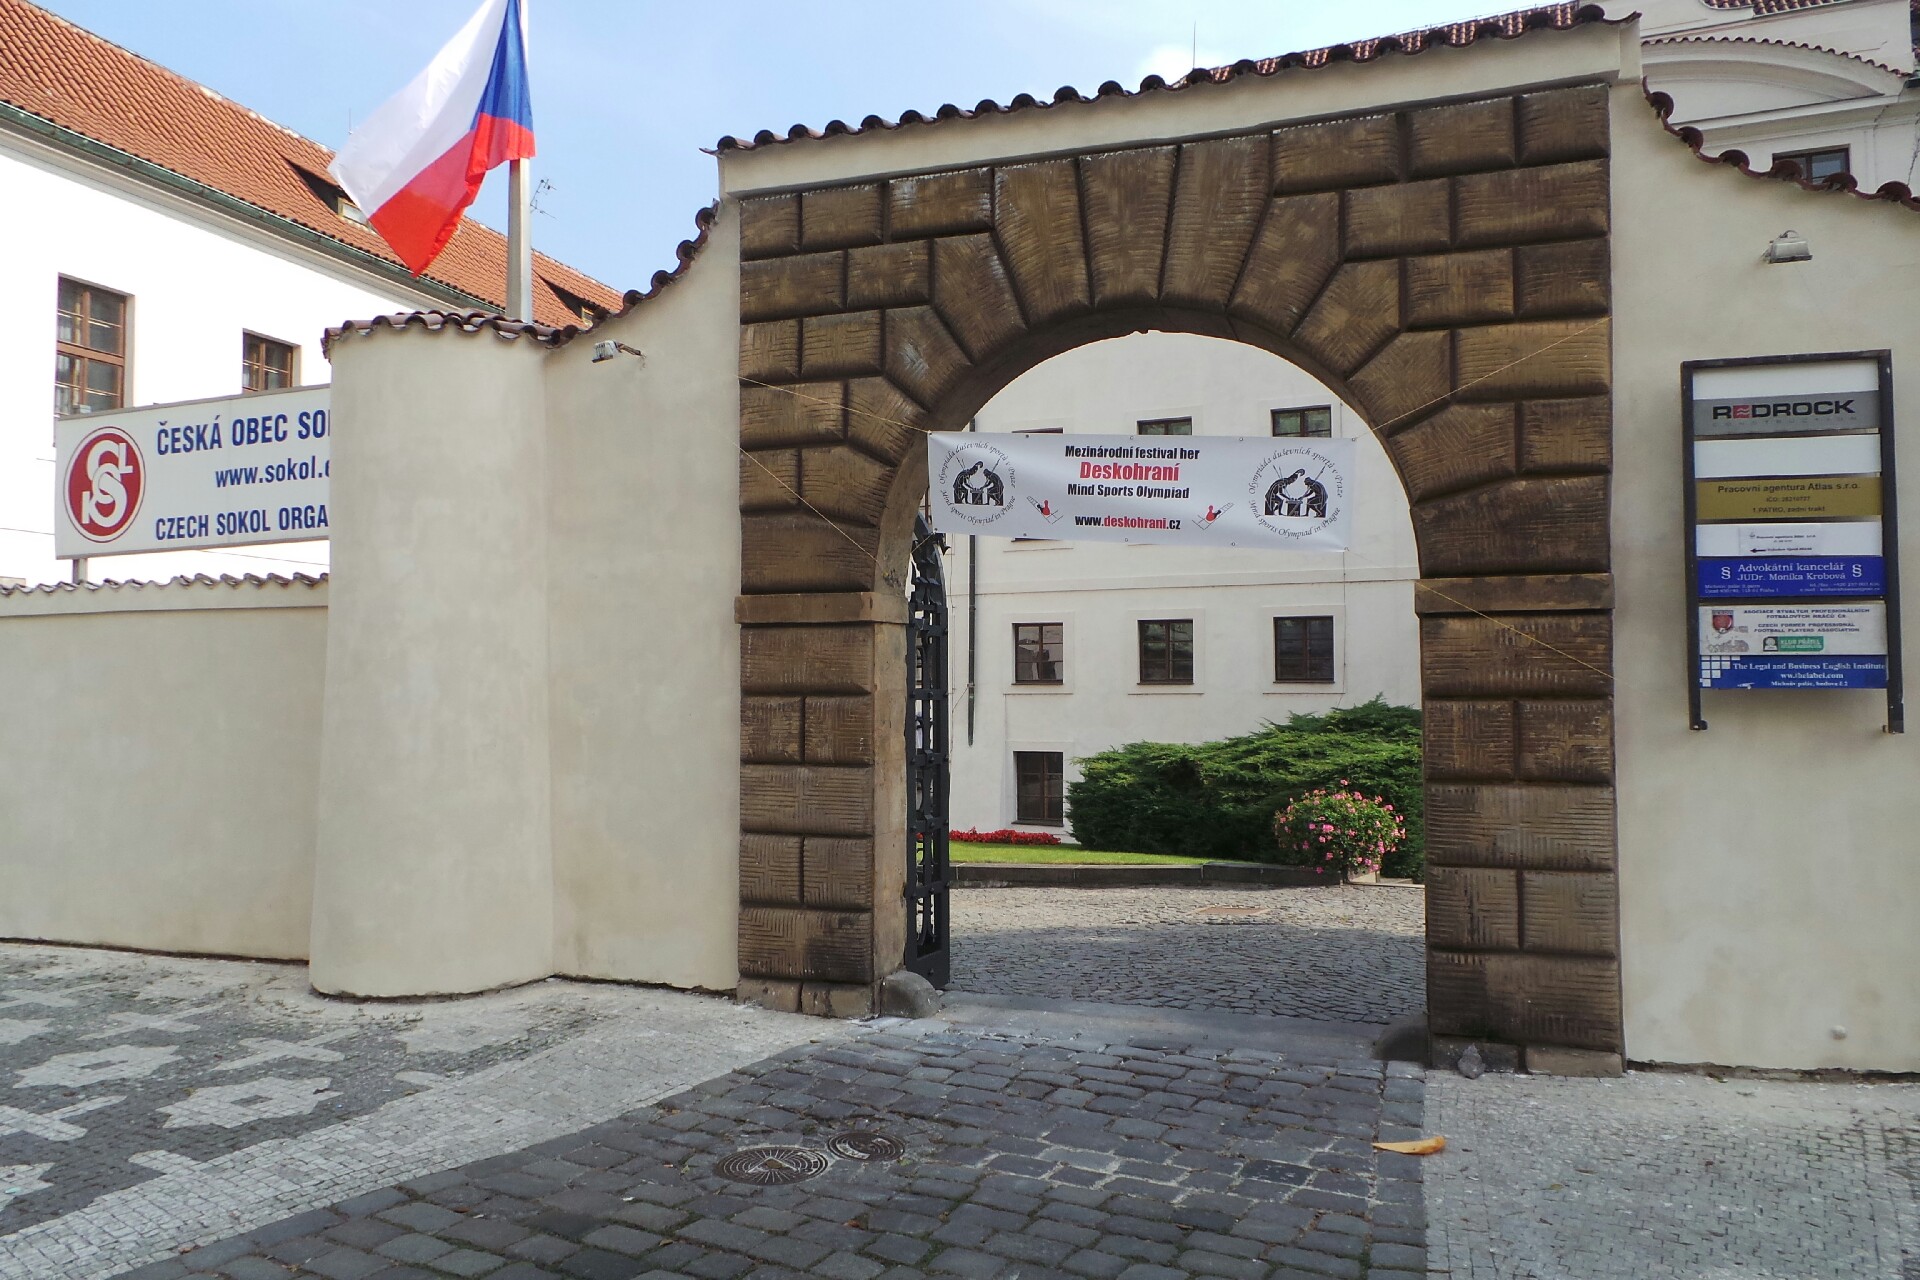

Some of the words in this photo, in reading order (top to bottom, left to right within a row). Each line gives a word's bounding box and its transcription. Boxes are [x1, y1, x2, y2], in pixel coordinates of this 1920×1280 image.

[1712, 400, 1856, 420] REDROCK
[157, 415, 222, 456] ČESKÁ
[232, 413, 288, 446] OBEC
[1065, 445, 1133, 459] Mezinárodní
[1136, 447, 1178, 459] festival
[1180, 448, 1200, 460] her
[1080, 461, 1181, 481] Deskohraní
[1067, 483, 1095, 496] Mind
[1097, 484, 1134, 497] Sports
[1136, 485, 1190, 499] Olympiad
[1763, 484, 1806, 495] agentura
[1807, 482, 1834, 491] Atlas
[156, 514, 209, 540] CZECH
[216, 509, 271, 536] SOKOL
[1075, 515, 1181, 530] www.deskohrani.cz
[1738, 563, 1793, 572] Advokátní
[1796, 561, 1845, 571] kancelář
[1737, 573, 1766, 581] JUDr.
[1769, 572, 1804, 581] Monika
[1807, 571, 1846, 581] Krobová
[1822, 663, 1852, 671] English
